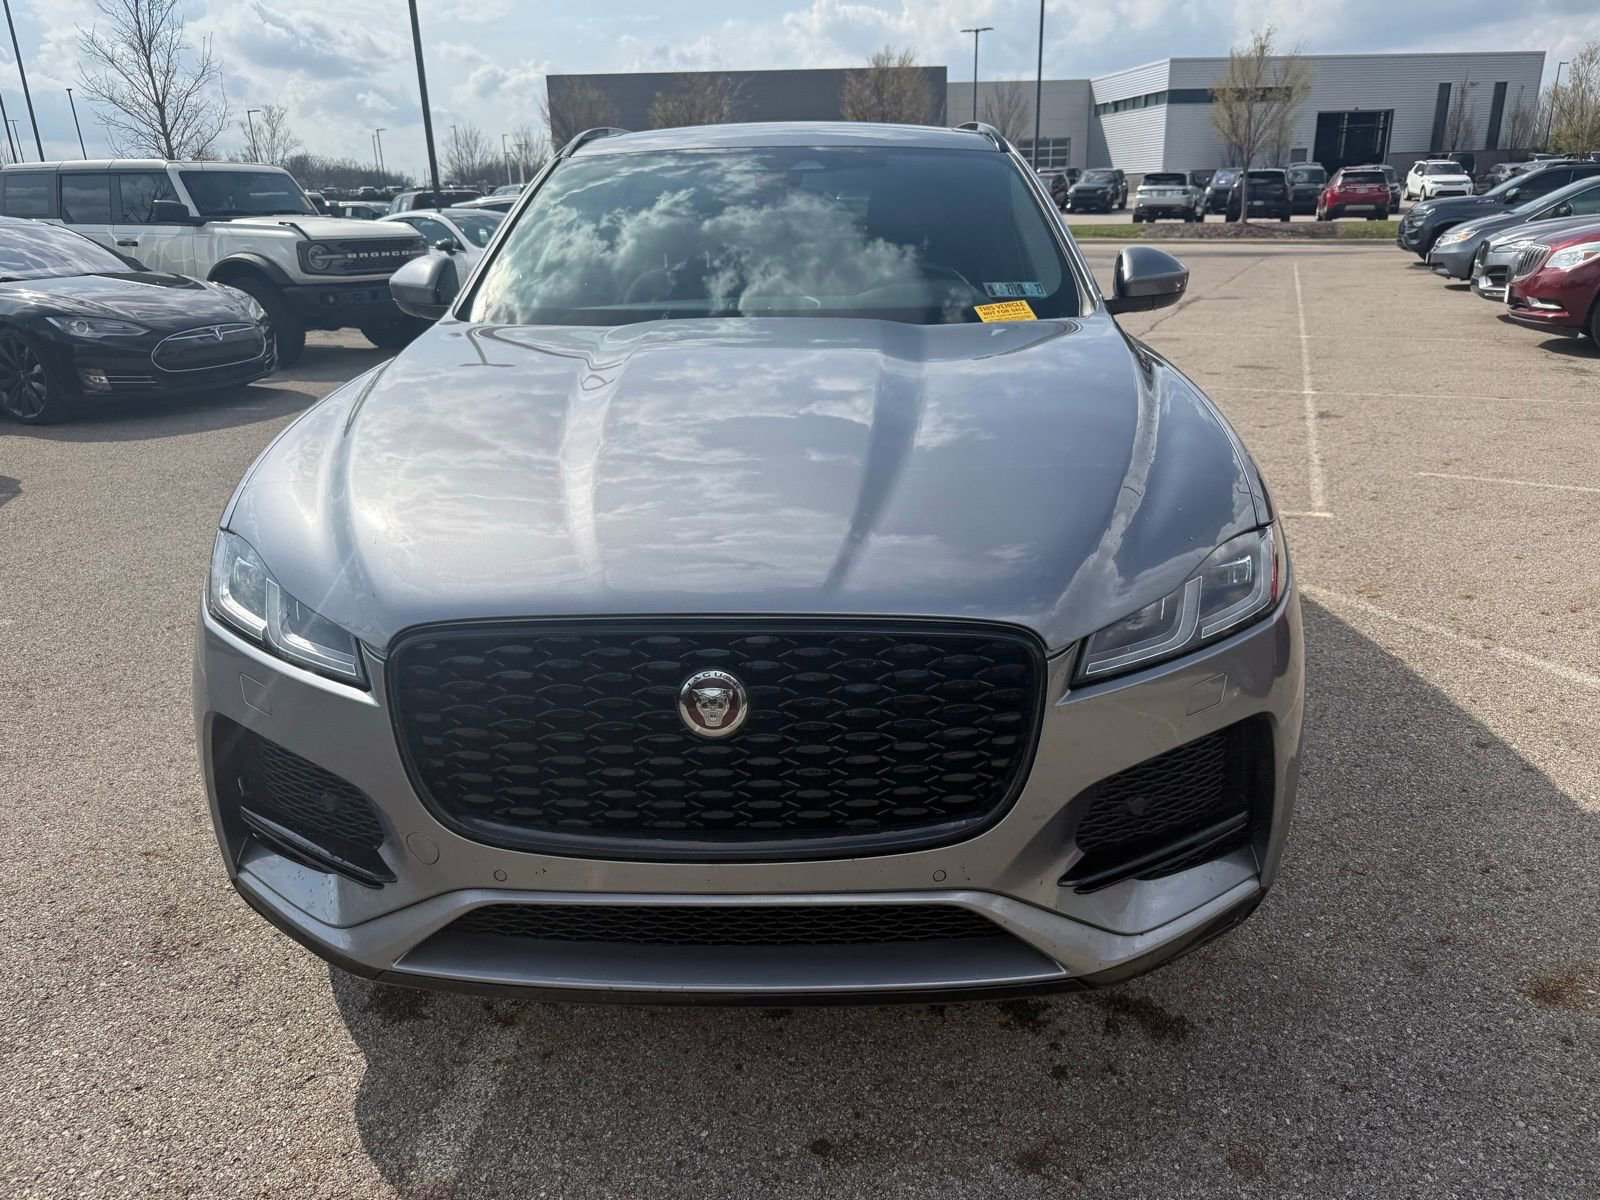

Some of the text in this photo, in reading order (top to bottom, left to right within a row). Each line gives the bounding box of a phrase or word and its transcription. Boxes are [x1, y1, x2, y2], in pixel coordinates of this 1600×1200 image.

[347, 250, 410, 259] BRONCO
[995, 302, 1025, 310] VEHICLE
[687, 671, 741, 689] JAGUAR
